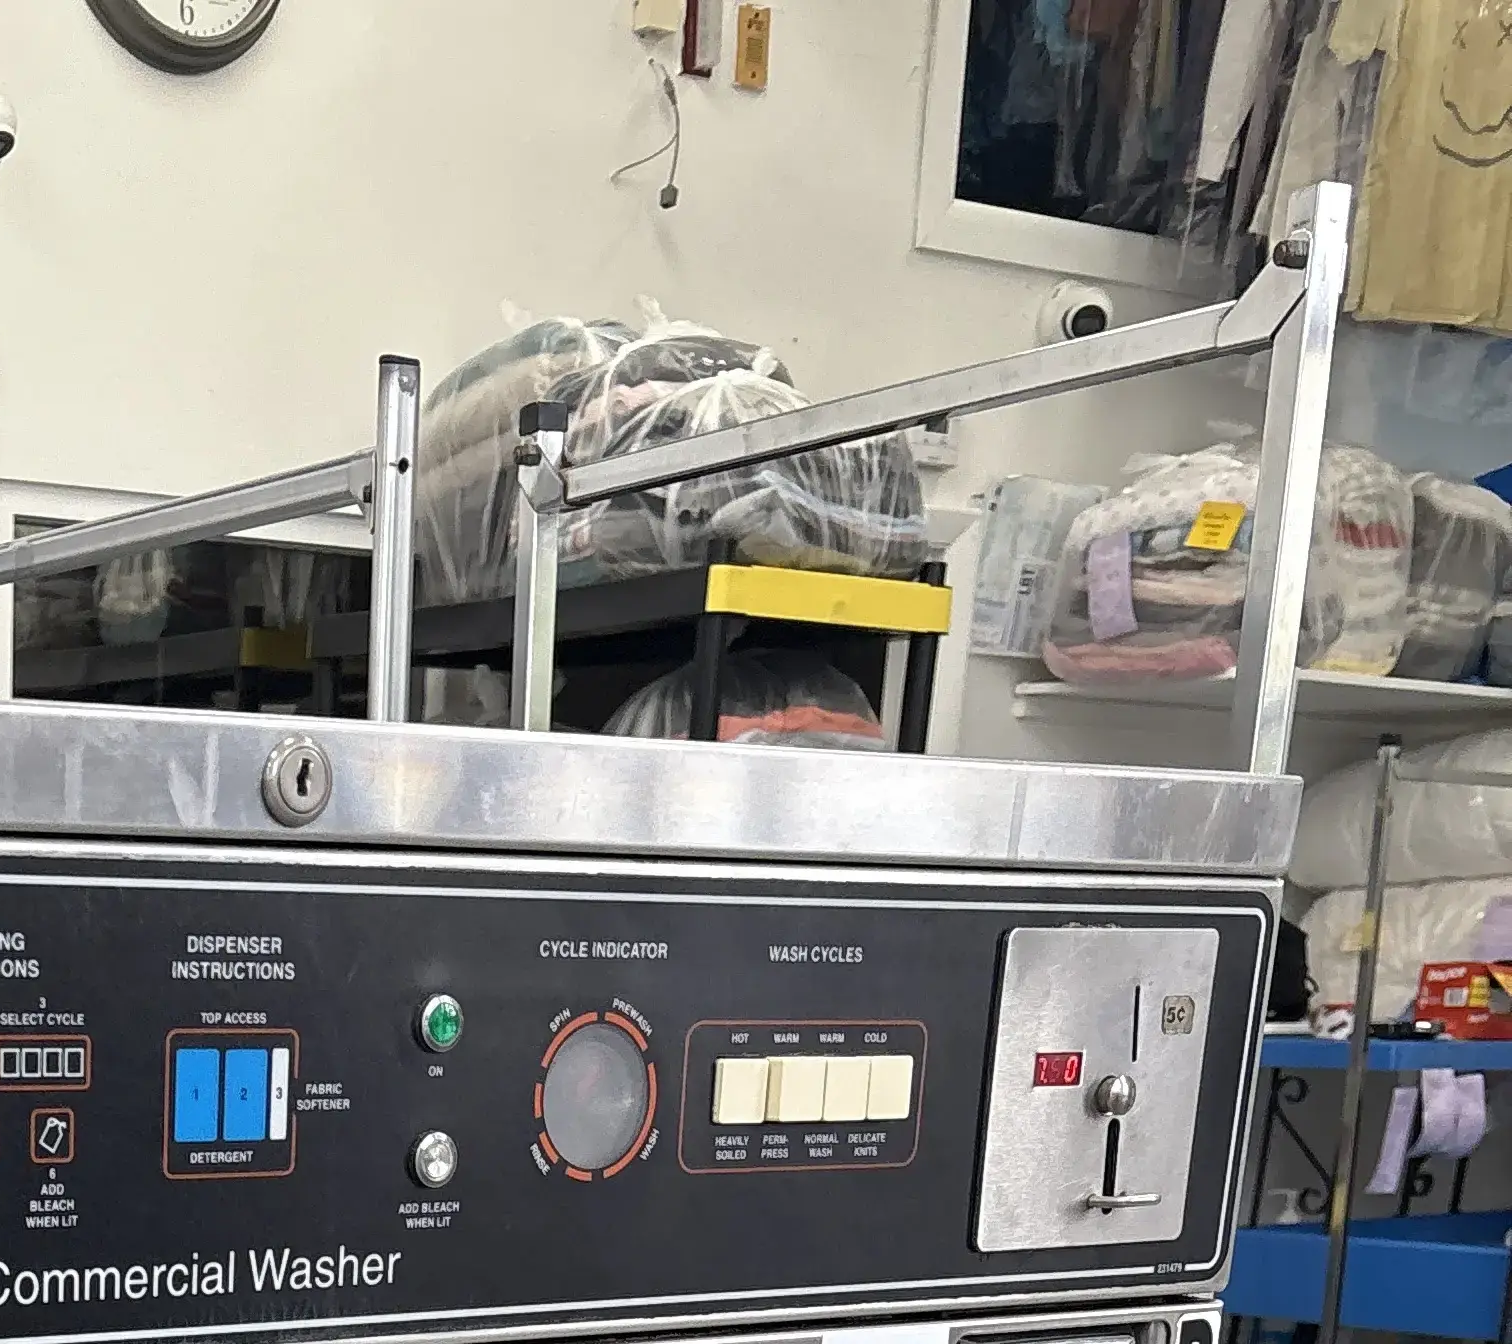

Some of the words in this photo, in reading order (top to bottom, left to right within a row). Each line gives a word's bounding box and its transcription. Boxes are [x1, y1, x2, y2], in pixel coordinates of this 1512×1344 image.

[187, 935, 283, 955] DISPENSER
[539, 940, 588, 959] CYCLE
[591, 940, 669, 960] INDICATOR
[768, 945, 808, 963] WASH
[811, 945, 864, 963] CYCLES
[171, 960, 296, 980] INSTRUCTIONS
[39, 997, 46, 1009] 3
[0, 1012, 44, 1027] SELECT
[47, 1012, 85, 1026] CYCLE
[200, 1012, 222, 1025] TOP
[224, 1012, 267, 1025] ACCESS
[549, 1007, 571, 1033] SPIN
[612, 997, 653, 1037] PREWASH
[731, 1032, 750, 1044] HOT
[773, 1032, 800, 1044] WARM
[819, 1032, 845, 1044] WARM
[864, 1032, 887, 1044] COLD
[427, 1065, 444, 1077] ON
[191, 1088, 199, 1101] 1
[239, 1087, 248, 1101] 2
[275, 1087, 283, 1100] 3
[305, 1083, 343, 1095] FABRIC
[296, 1098, 351, 1111] SOFTENER
[639, 1127, 660, 1161] WASH
[714, 1135, 750, 1147] HEAVILY
[804, 1132, 839, 1145] NORMAL
[847, 1132, 887, 1144] DELICATE
[189, 1150, 254, 1164] DETERGENT
[715, 1149, 747, 1161] SOILED
[760, 1147, 789, 1159] PRESS
[808, 1146, 833, 1158] WASH
[853, 1146, 878, 1157] KNITS
[529, 1142, 551, 1176] RINSE
[48, 1167, 56, 1180] 6
[40, 1183, 65, 1196] ADD
[29, 1199, 75, 1212] BLEACH
[397, 1202, 419, 1215] ADD
[421, 1201, 460, 1214] BLEACH
[25, 1216, 60, 1229] WHEN
[62, 1214, 79, 1228] LIT
[405, 1217, 435, 1229] WHEN
[436, 1216, 451, 1228] LIT
[248, 1245, 402, 1293] Washer
